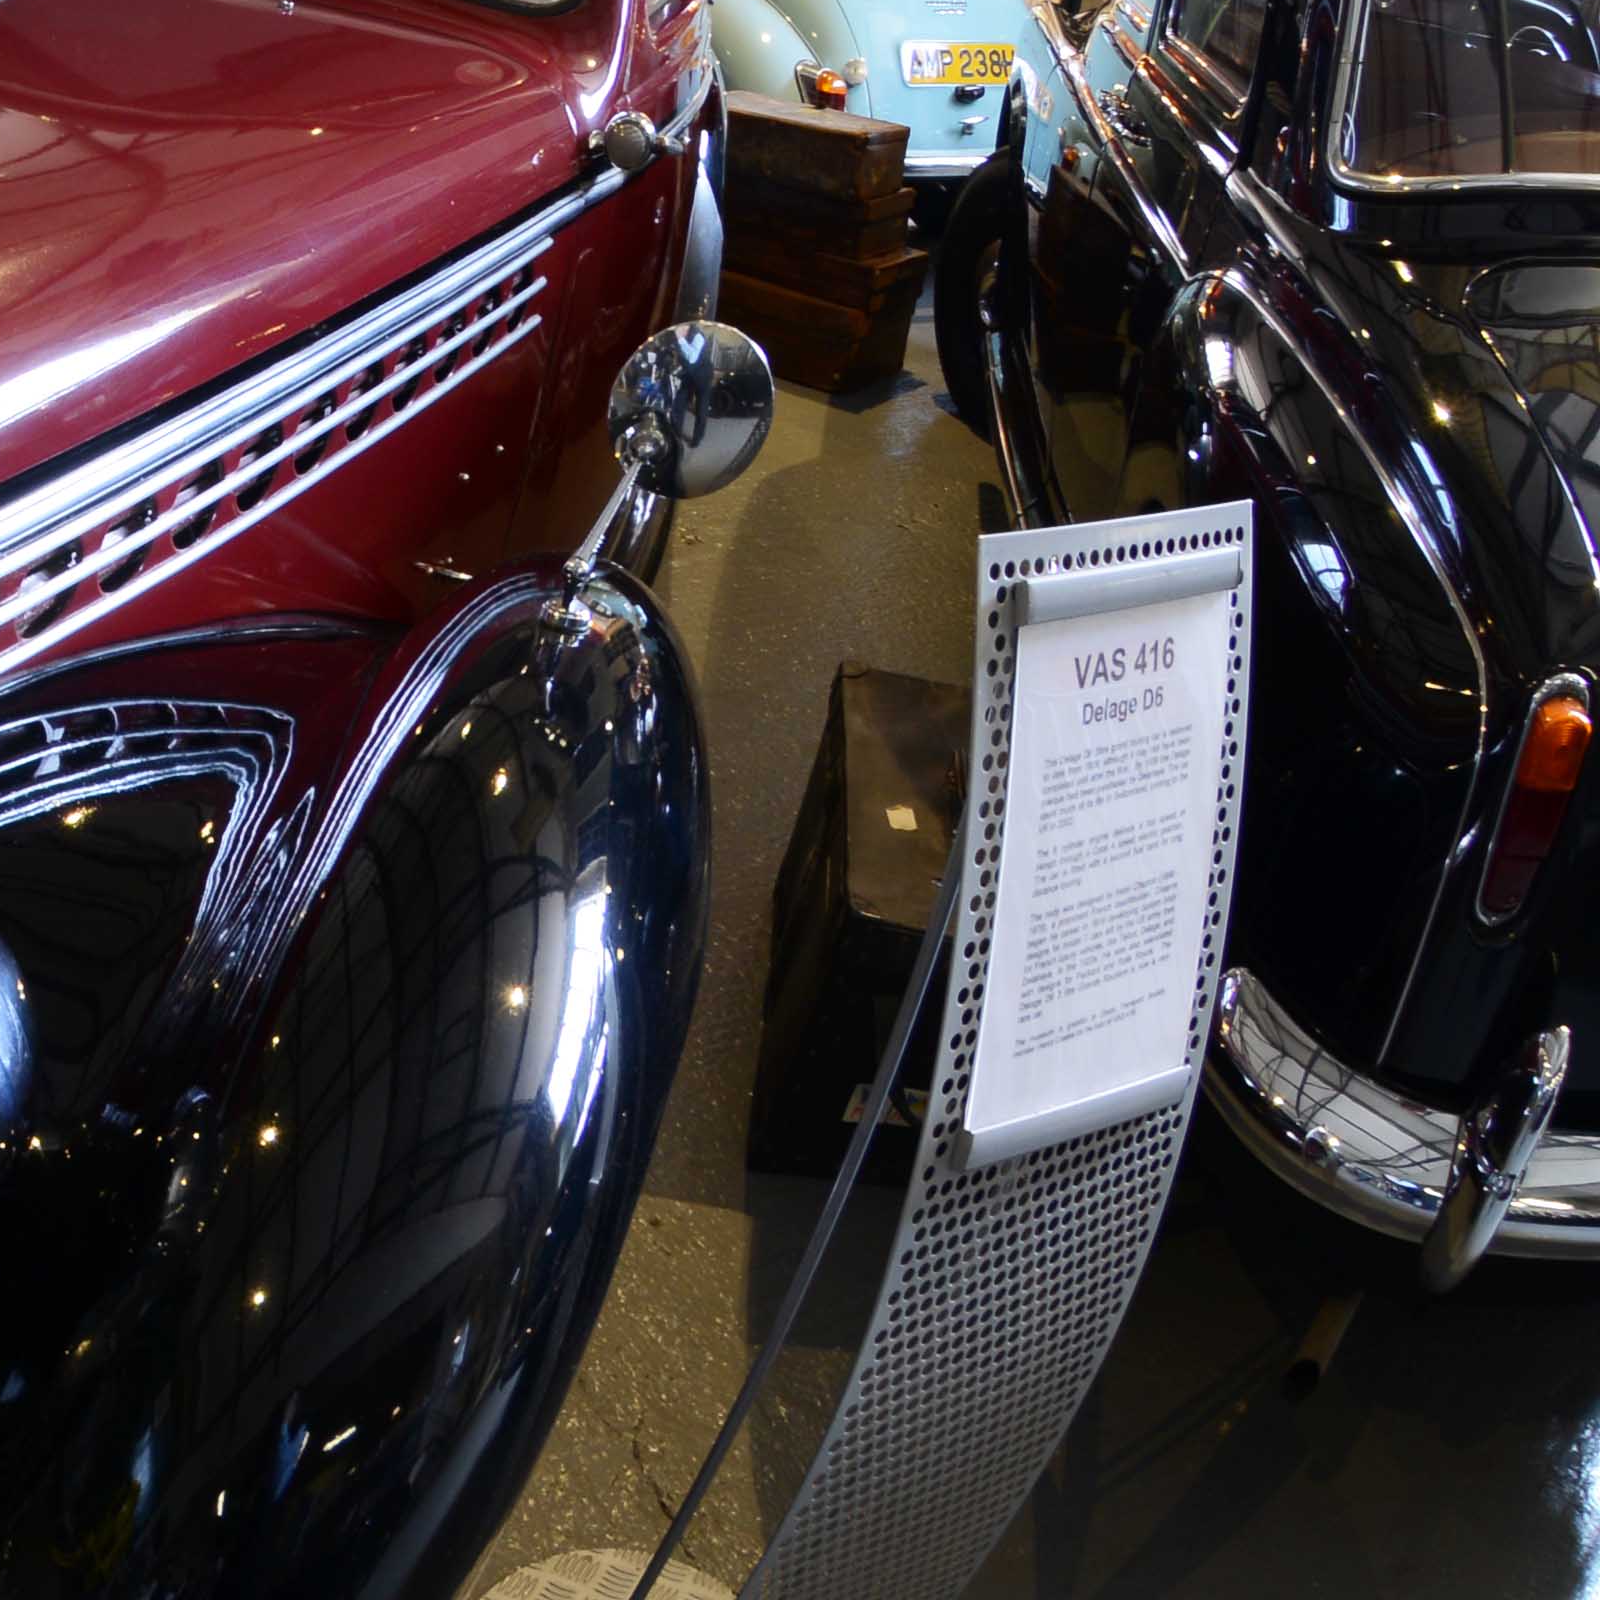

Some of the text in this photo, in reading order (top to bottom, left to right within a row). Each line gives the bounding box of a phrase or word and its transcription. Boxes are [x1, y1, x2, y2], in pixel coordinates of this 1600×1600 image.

[911, 48, 1015, 79] AMP 238H
[1074, 636, 1175, 689] VAS 416
[1082, 686, 1163, 725] Delage D6
